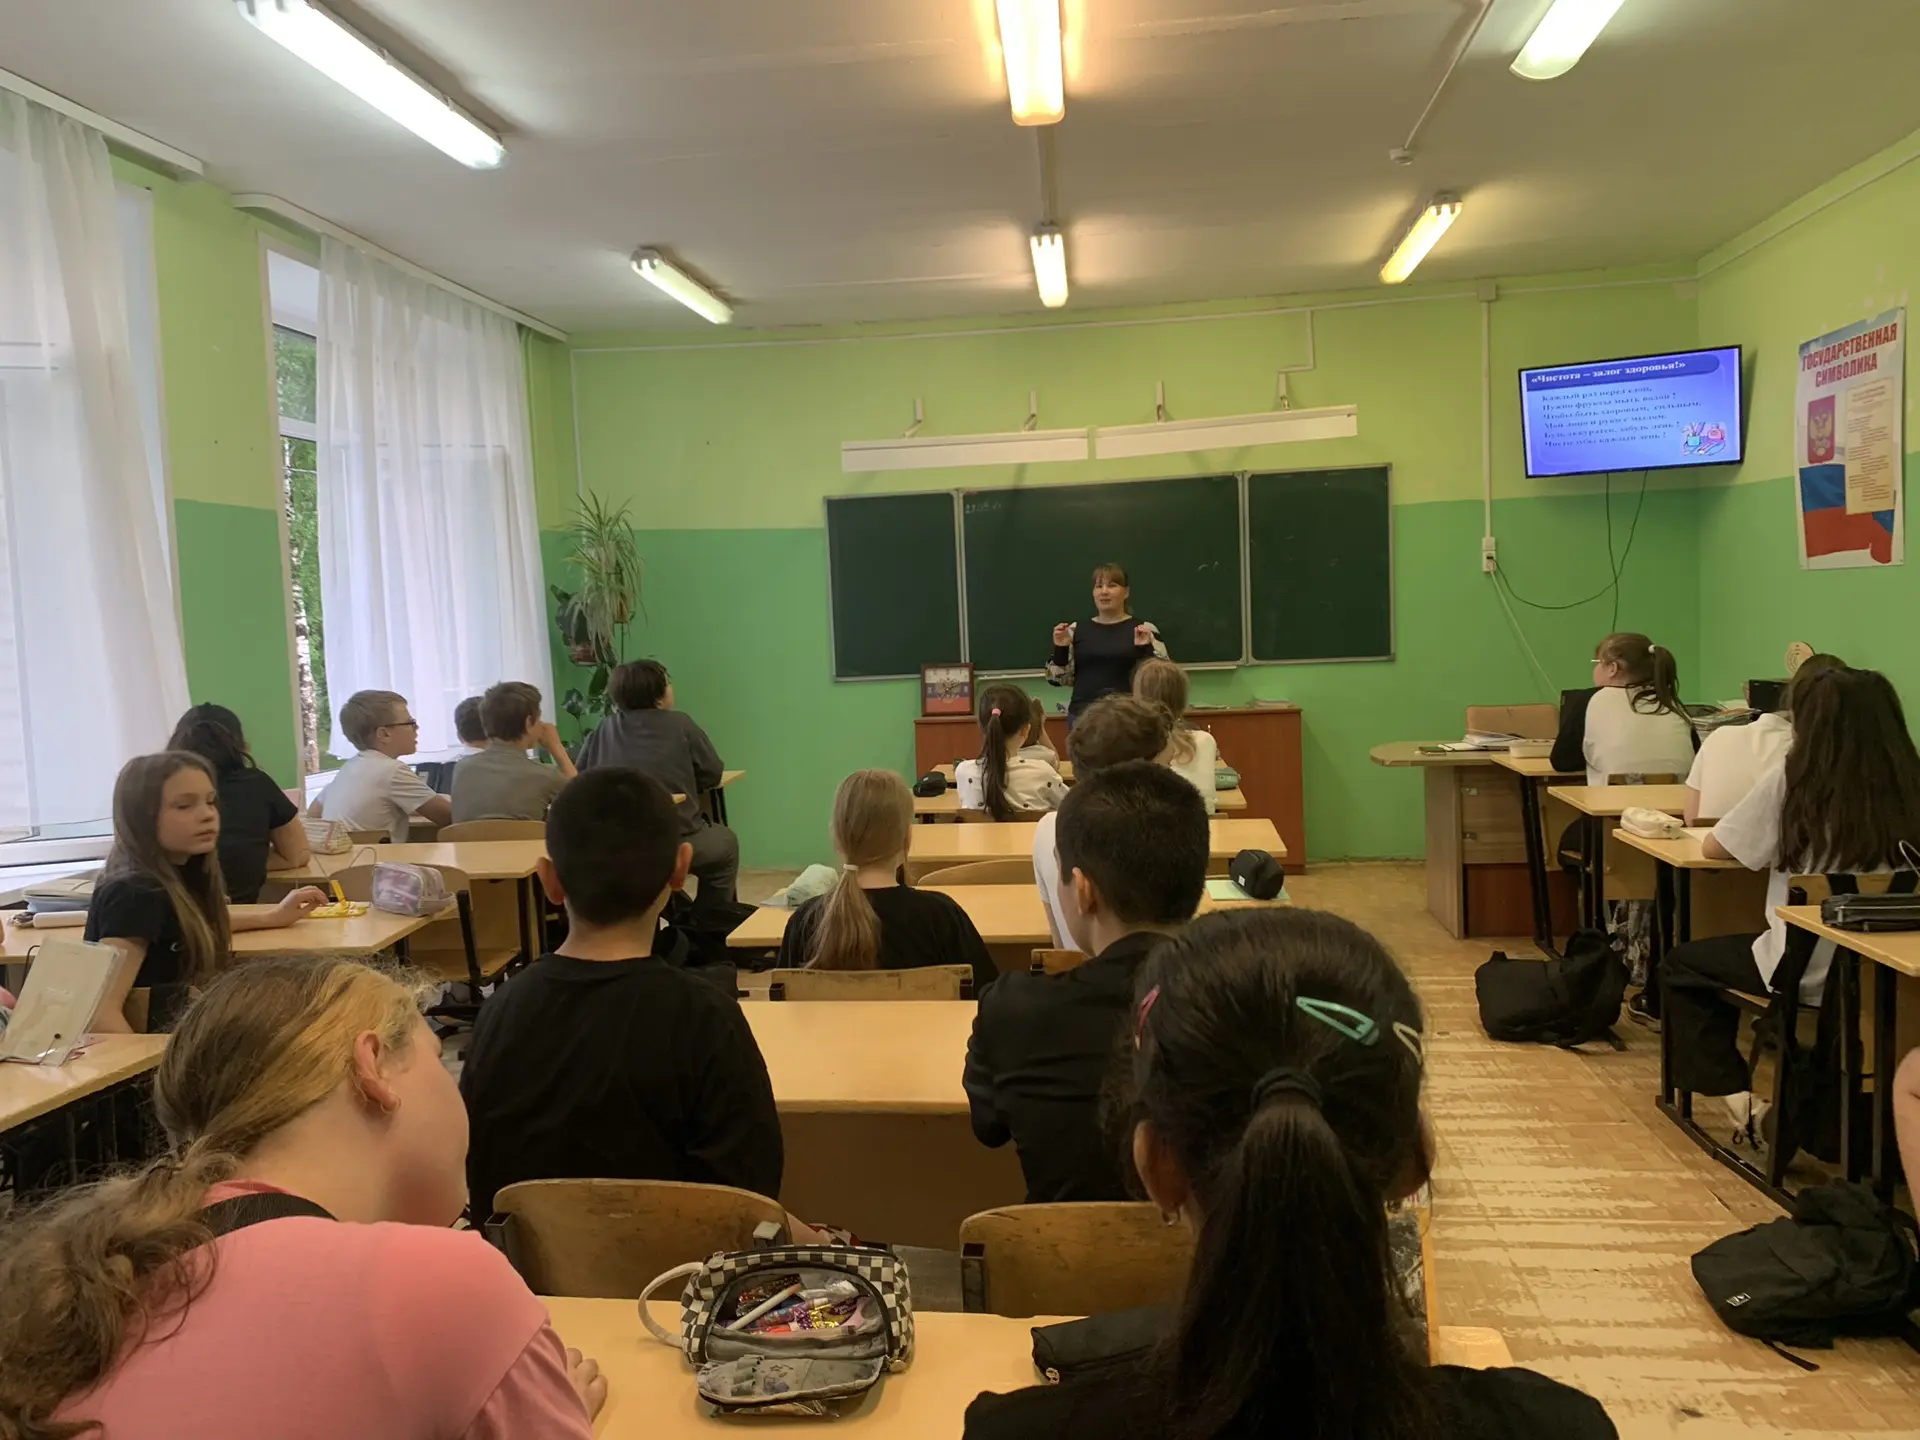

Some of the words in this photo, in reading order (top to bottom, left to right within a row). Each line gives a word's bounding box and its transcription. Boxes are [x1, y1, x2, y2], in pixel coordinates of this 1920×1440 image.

[1802, 322, 1897, 371] ГОСУДАРСТВЕННАЯ
[1531, 373, 1581, 383] «Чистота
[1592, 368, 1622, 378] залог
[1626, 361, 1686, 374] здоровья!»
[1815, 352, 1878, 388] СИМВОЛИКА
